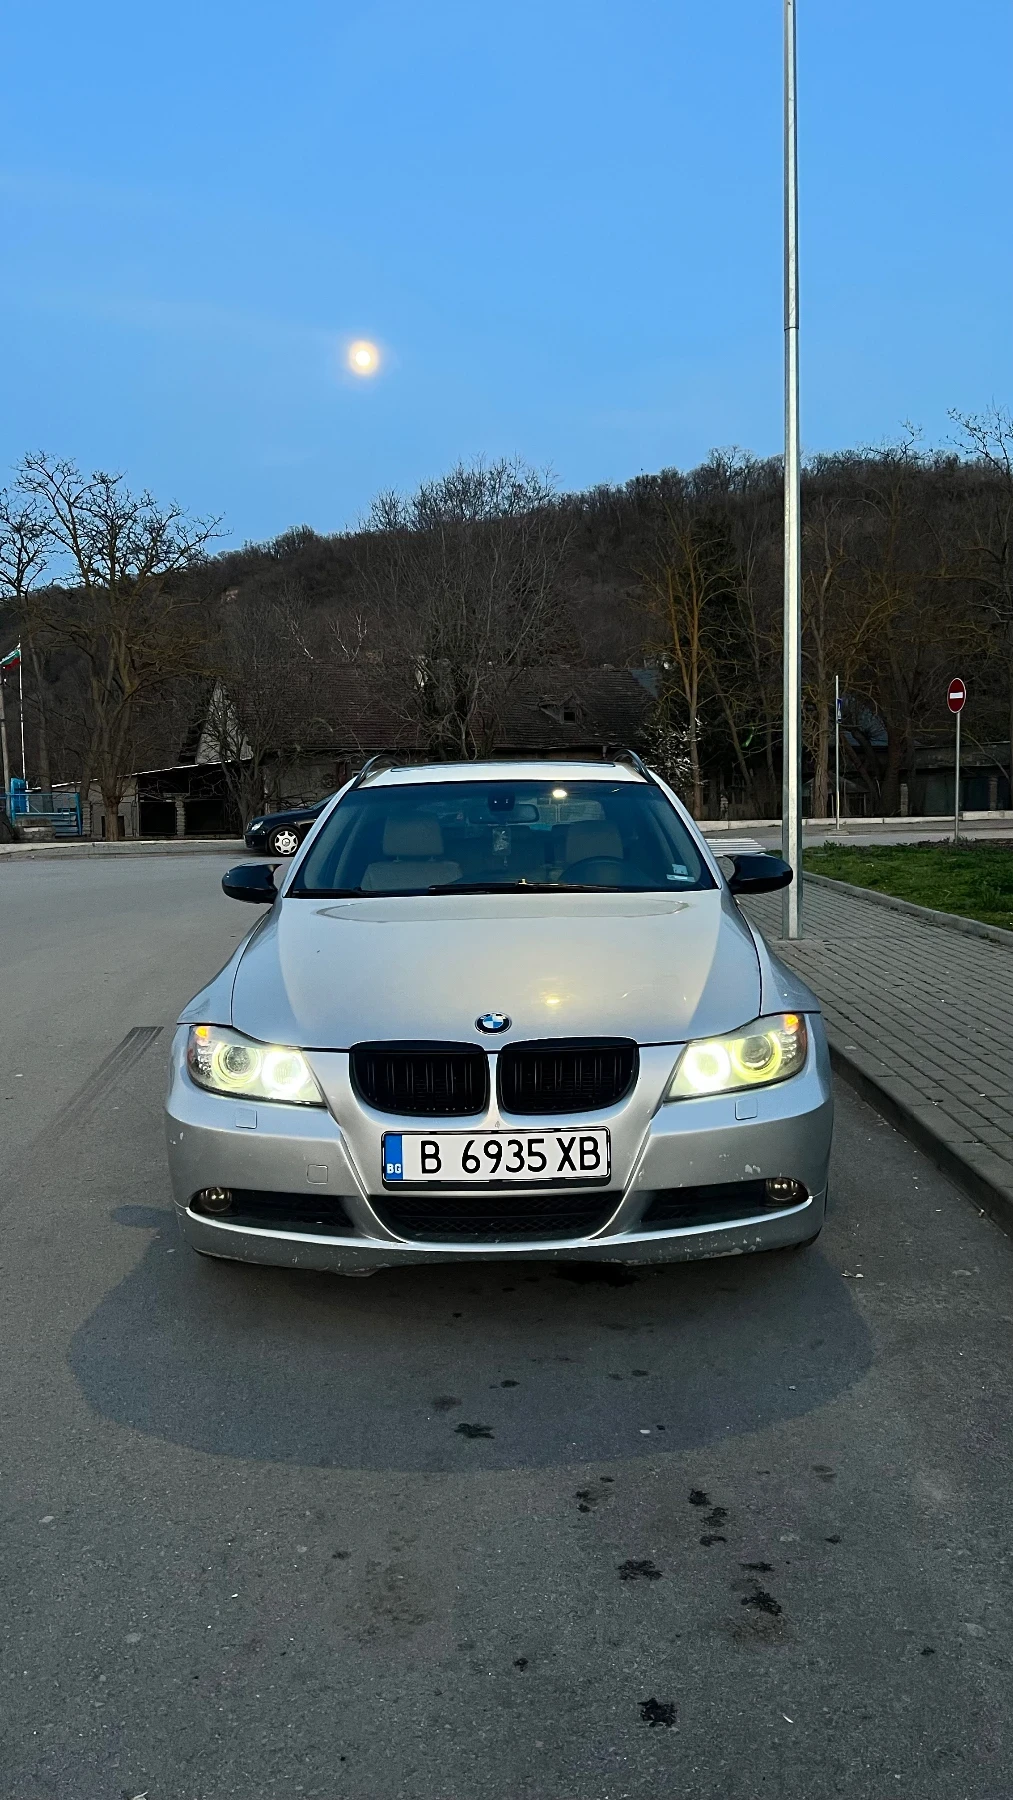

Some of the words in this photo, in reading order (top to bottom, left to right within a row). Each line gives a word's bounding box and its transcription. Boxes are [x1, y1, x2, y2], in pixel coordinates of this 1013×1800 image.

[420, 1140, 442, 1174] B
[461, 1139, 547, 1174] 6935
[556, 1136, 601, 1172] XB
[386, 1163, 402, 1174] BG
